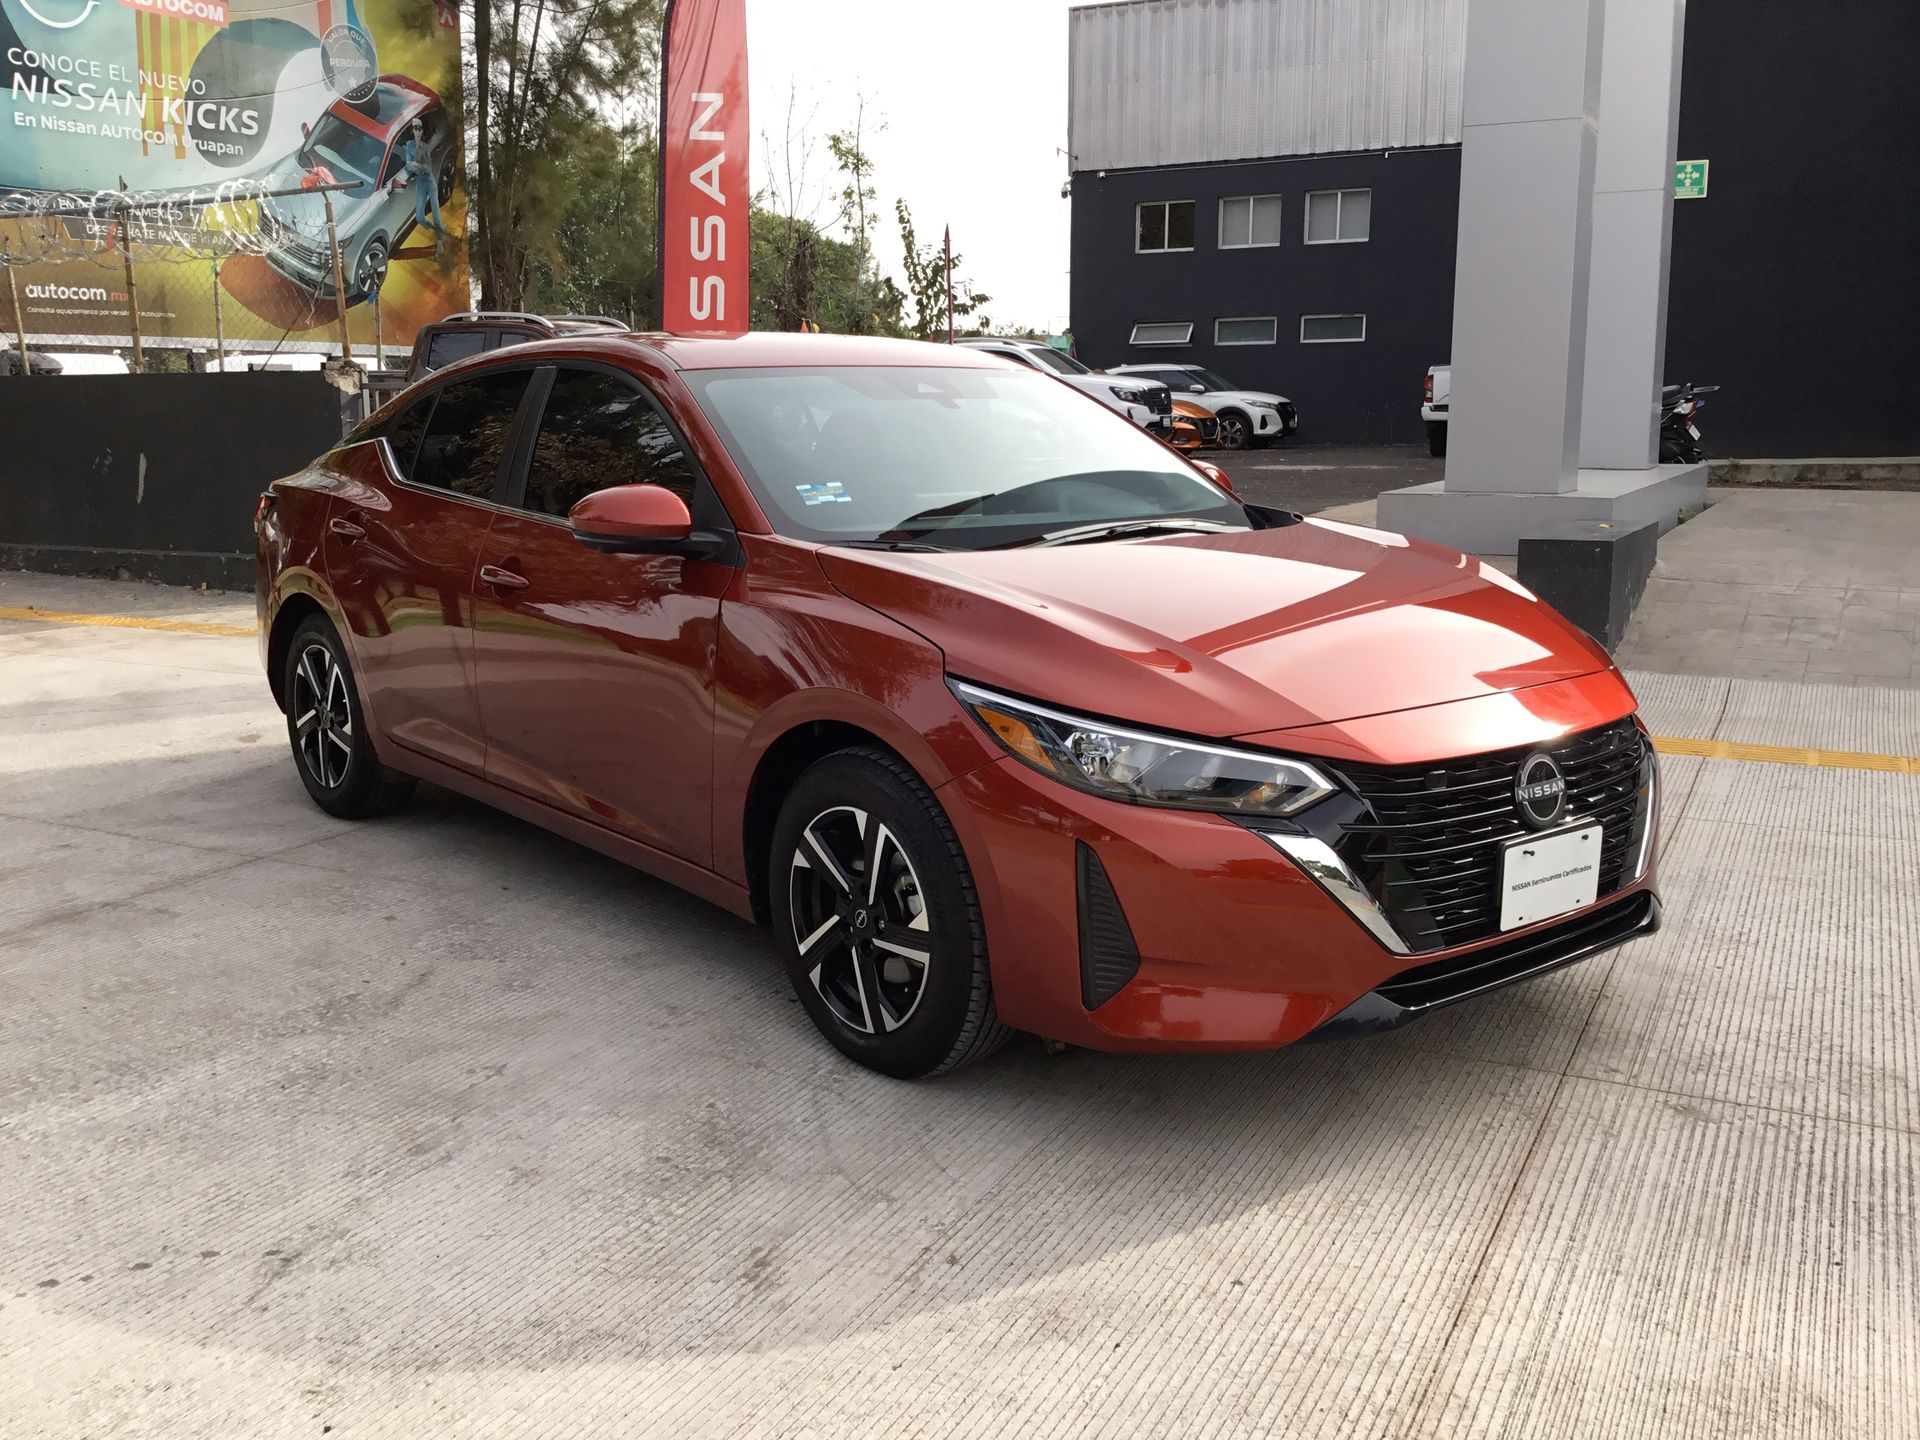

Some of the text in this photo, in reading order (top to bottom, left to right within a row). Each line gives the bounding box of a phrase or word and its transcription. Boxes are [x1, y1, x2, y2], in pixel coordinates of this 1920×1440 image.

[124, 0, 224, 22] TOCOM
[327, 28, 349, 44] VALOR
[7, 47, 206, 95] CONOCE EL NUEVO
[11, 72, 260, 136] NISSAN KICKS
[13, 111, 244, 156] En Nissan AUTOCOM Uruapan
[1517, 779, 1565, 800] NISSAN
[1511, 865, 1592, 892] NISSAN Seminuevos Certificados
